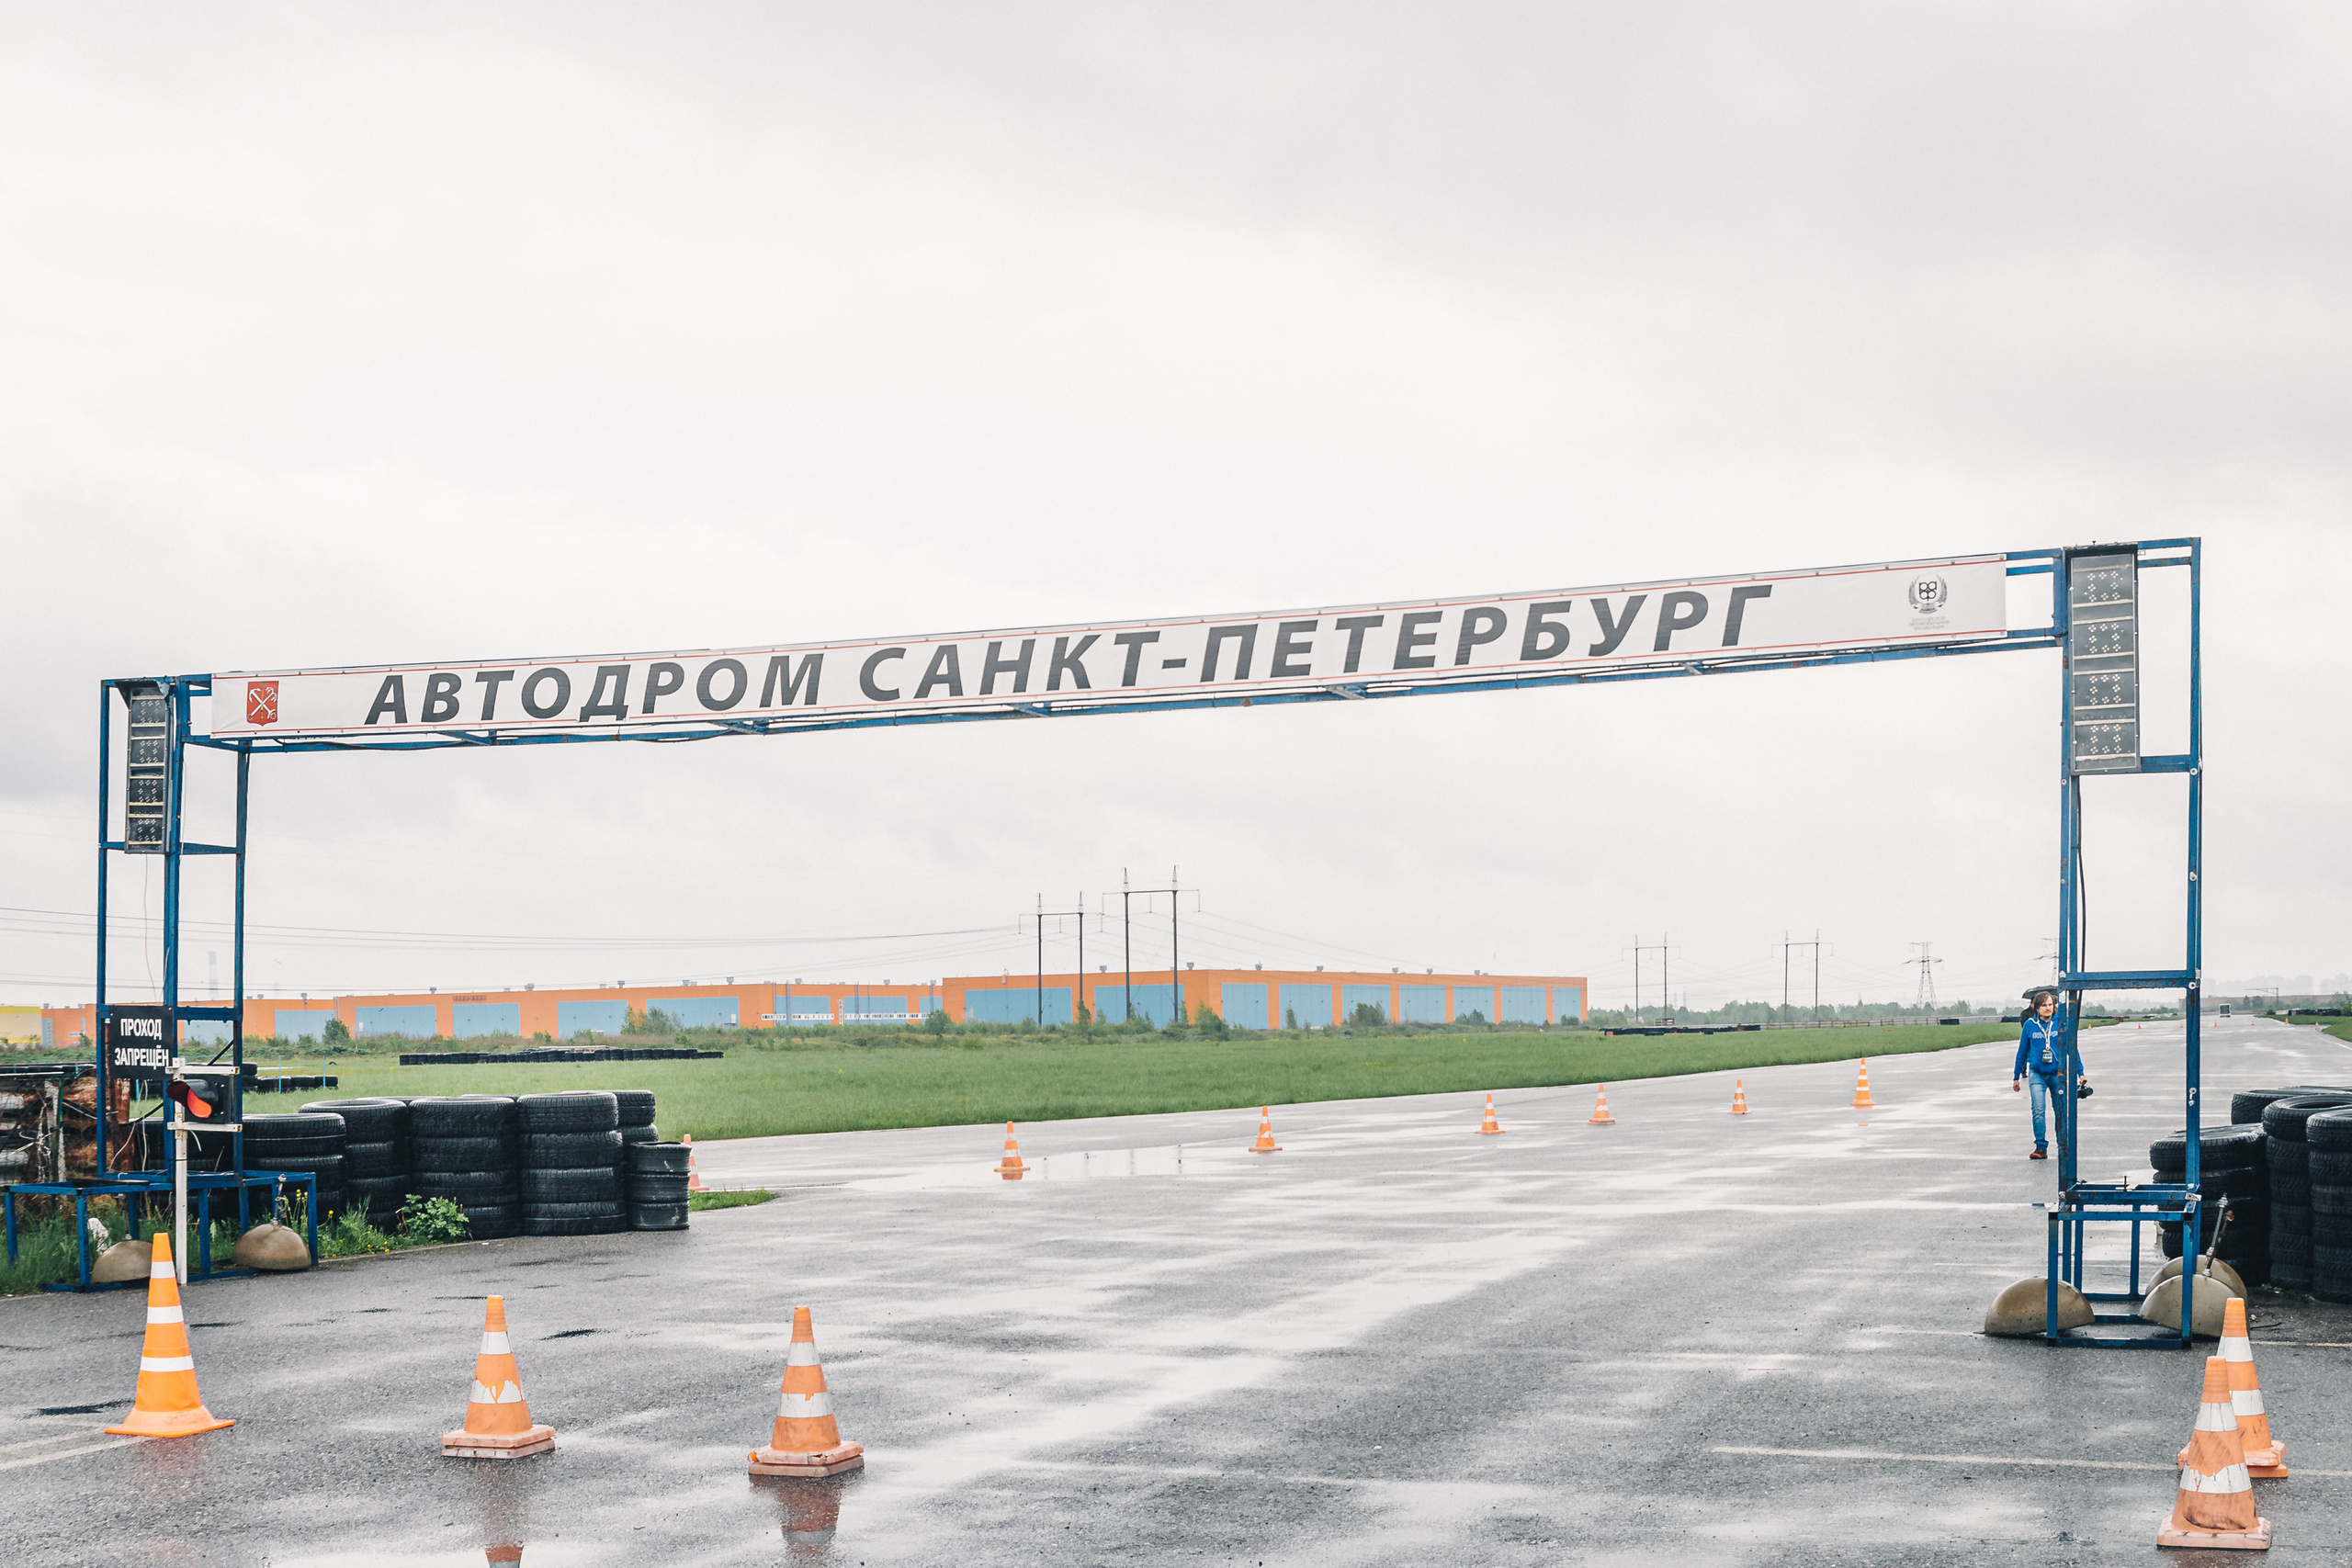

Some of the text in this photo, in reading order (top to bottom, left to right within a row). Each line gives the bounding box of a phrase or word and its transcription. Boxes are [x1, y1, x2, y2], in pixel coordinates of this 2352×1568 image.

[364, 584, 1773, 726] АВТОДРОМ САНКТ-ПЕТЕРБУРГ
[120, 1018, 163, 1041] ПРОХОД
[114, 1044, 169, 1070] ЗАПРЕЩЁН
